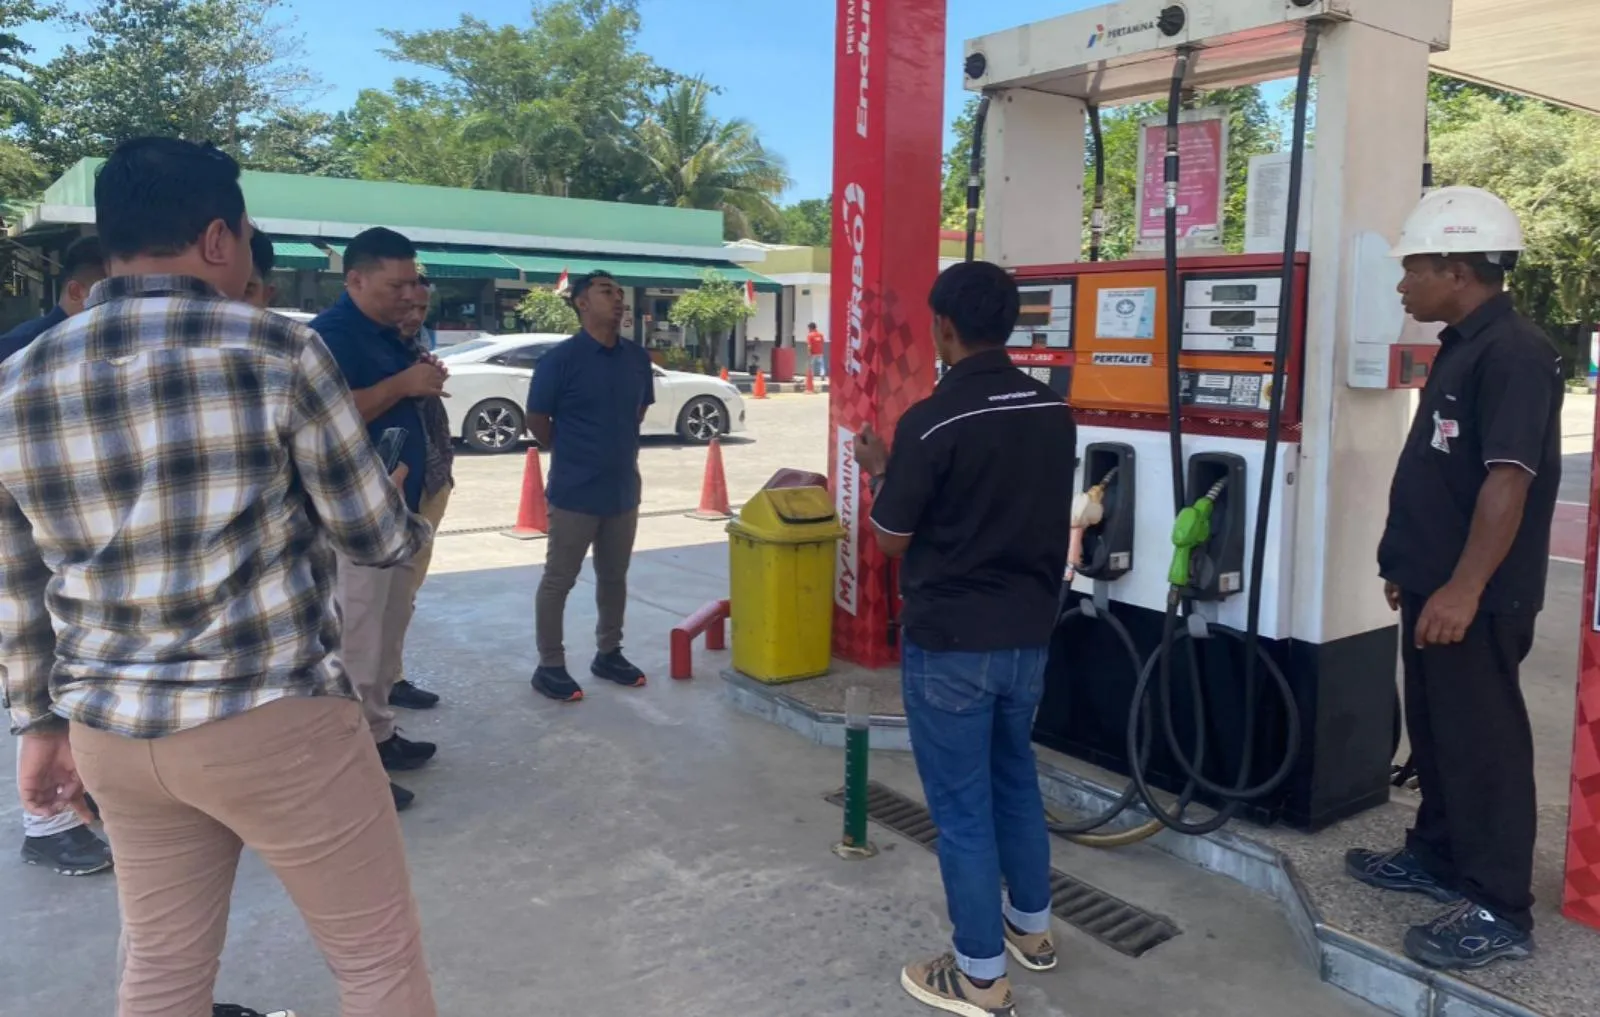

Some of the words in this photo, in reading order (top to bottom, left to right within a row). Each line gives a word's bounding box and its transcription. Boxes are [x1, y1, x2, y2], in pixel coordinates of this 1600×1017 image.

[1107, 21, 1154, 38] PERTAMINA
[850, 214, 865, 375] TURBO
[1094, 354, 1149, 364] PERTALITE
